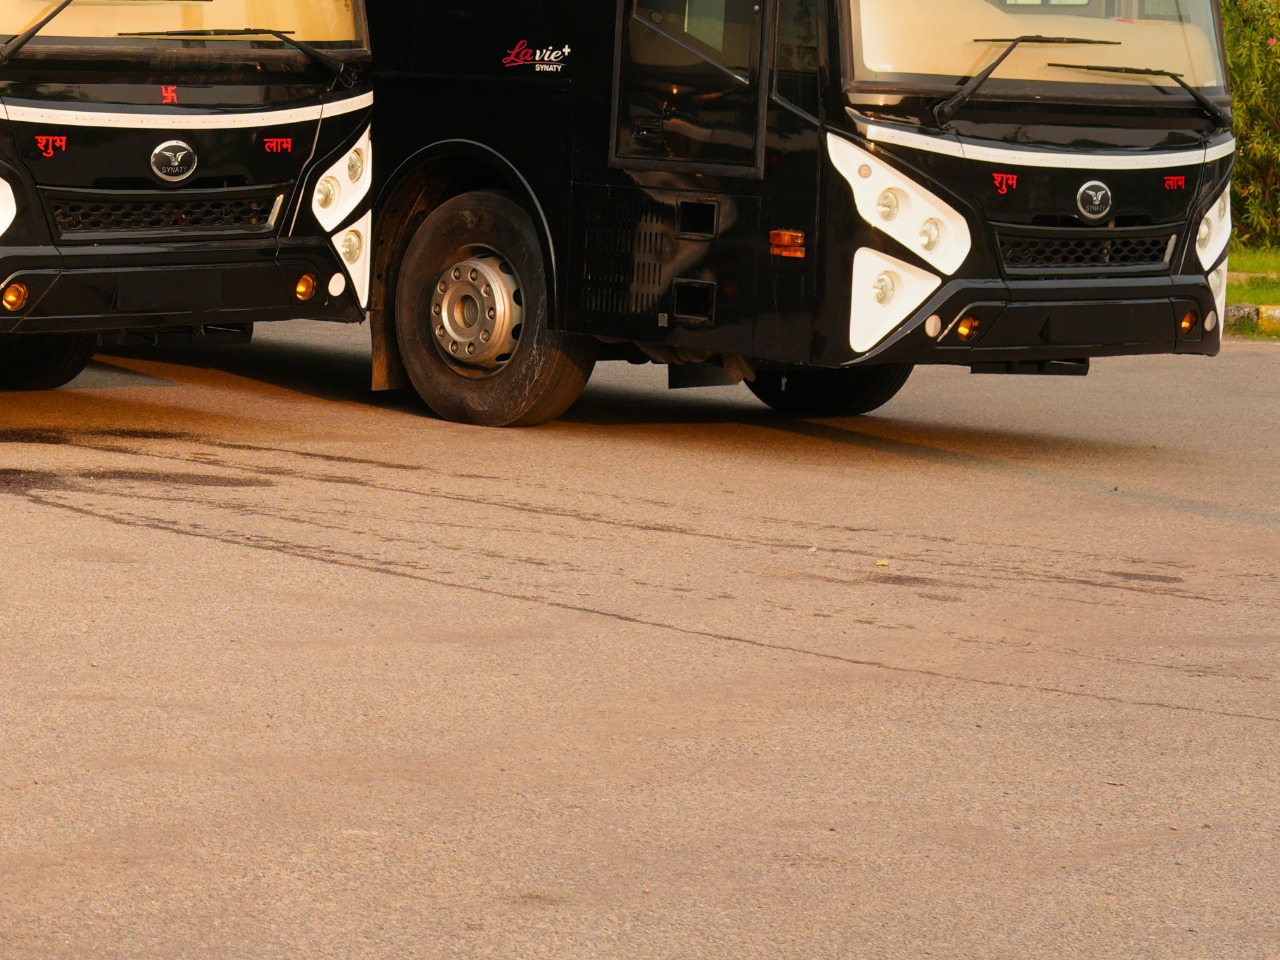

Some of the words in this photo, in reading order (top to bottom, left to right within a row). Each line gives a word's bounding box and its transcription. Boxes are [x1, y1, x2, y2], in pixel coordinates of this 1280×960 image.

[535, 64, 562, 72] SYNATY
[35, 135, 67, 157] शुभ
[263, 137, 292, 153] लाभ
[161, 166, 188, 174] SYNATY
[992, 173, 1018, 194] शुभ
[1163, 175, 1186, 190] लाभ
